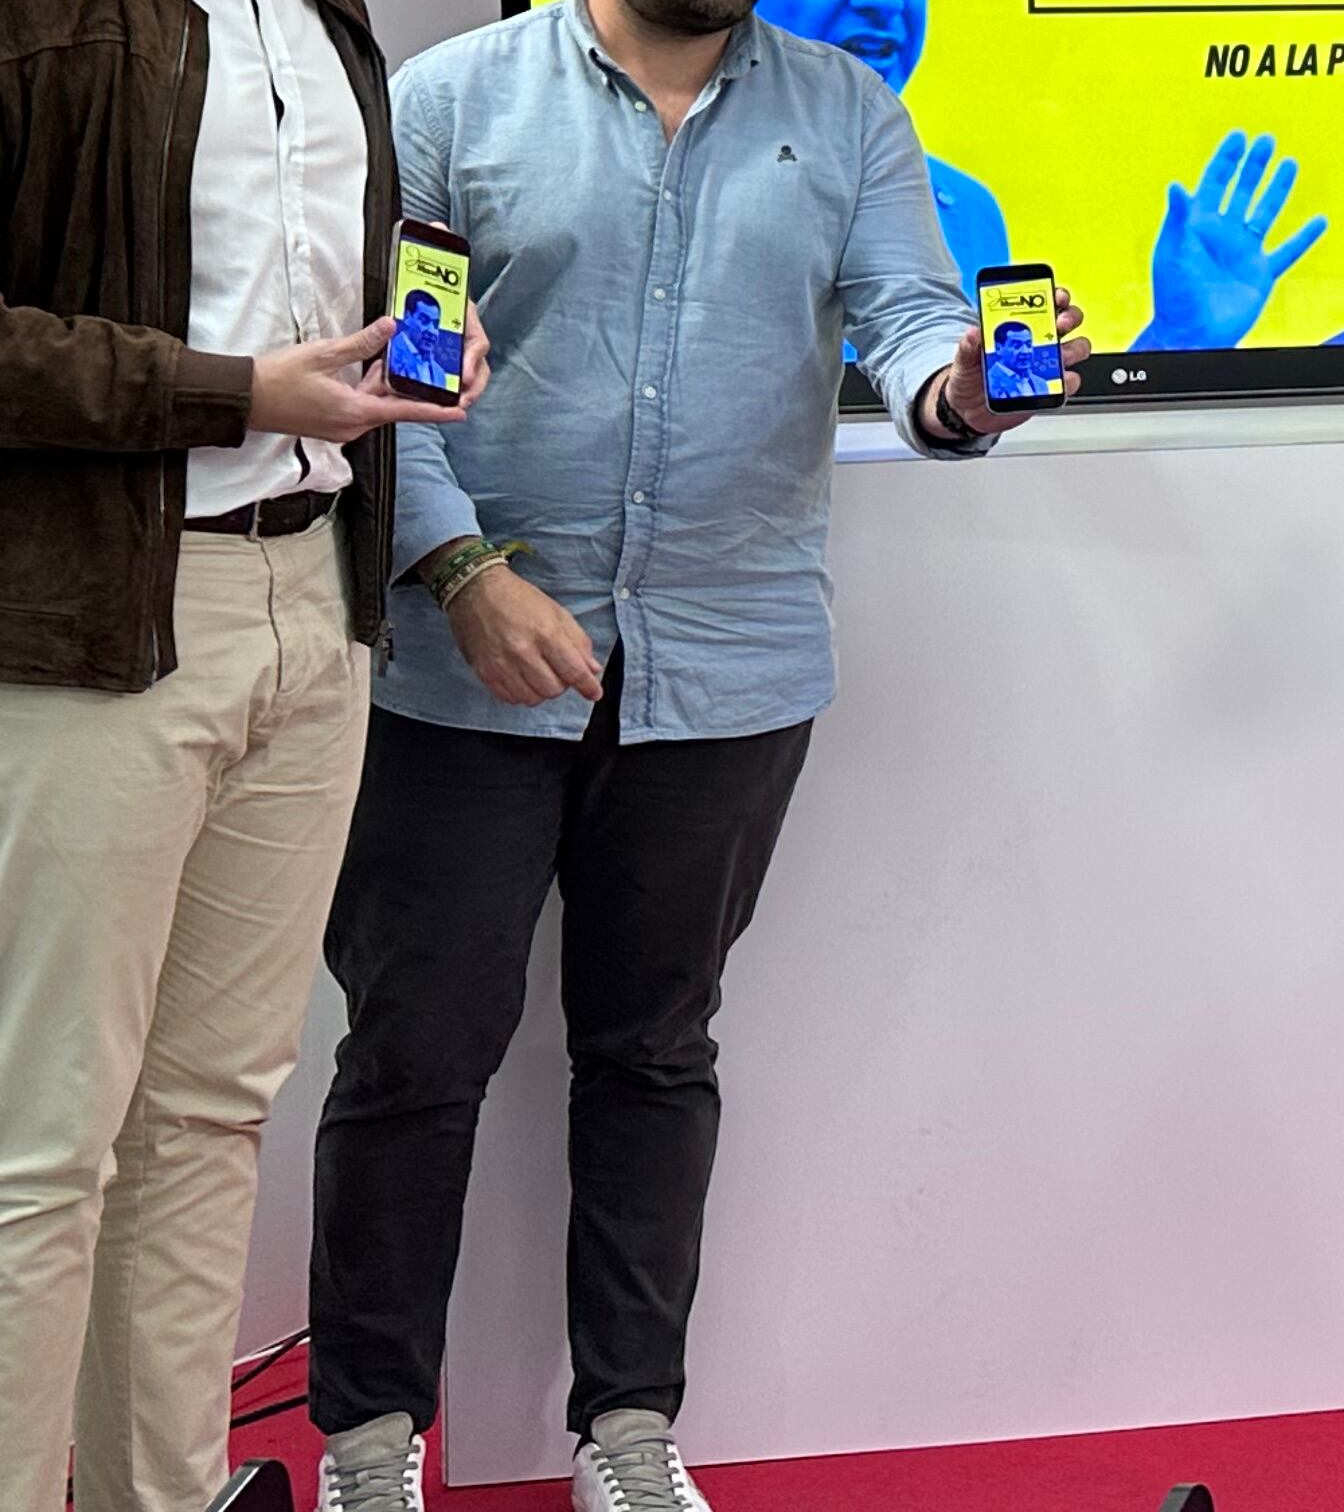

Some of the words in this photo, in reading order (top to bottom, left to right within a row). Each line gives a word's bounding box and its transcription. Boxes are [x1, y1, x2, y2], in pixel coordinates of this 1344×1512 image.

[1204, 44, 1251, 78] NO
[1255, 44, 1276, 77] A
[1285, 43, 1318, 77] LA
[1129, 370, 1147, 381] LG
